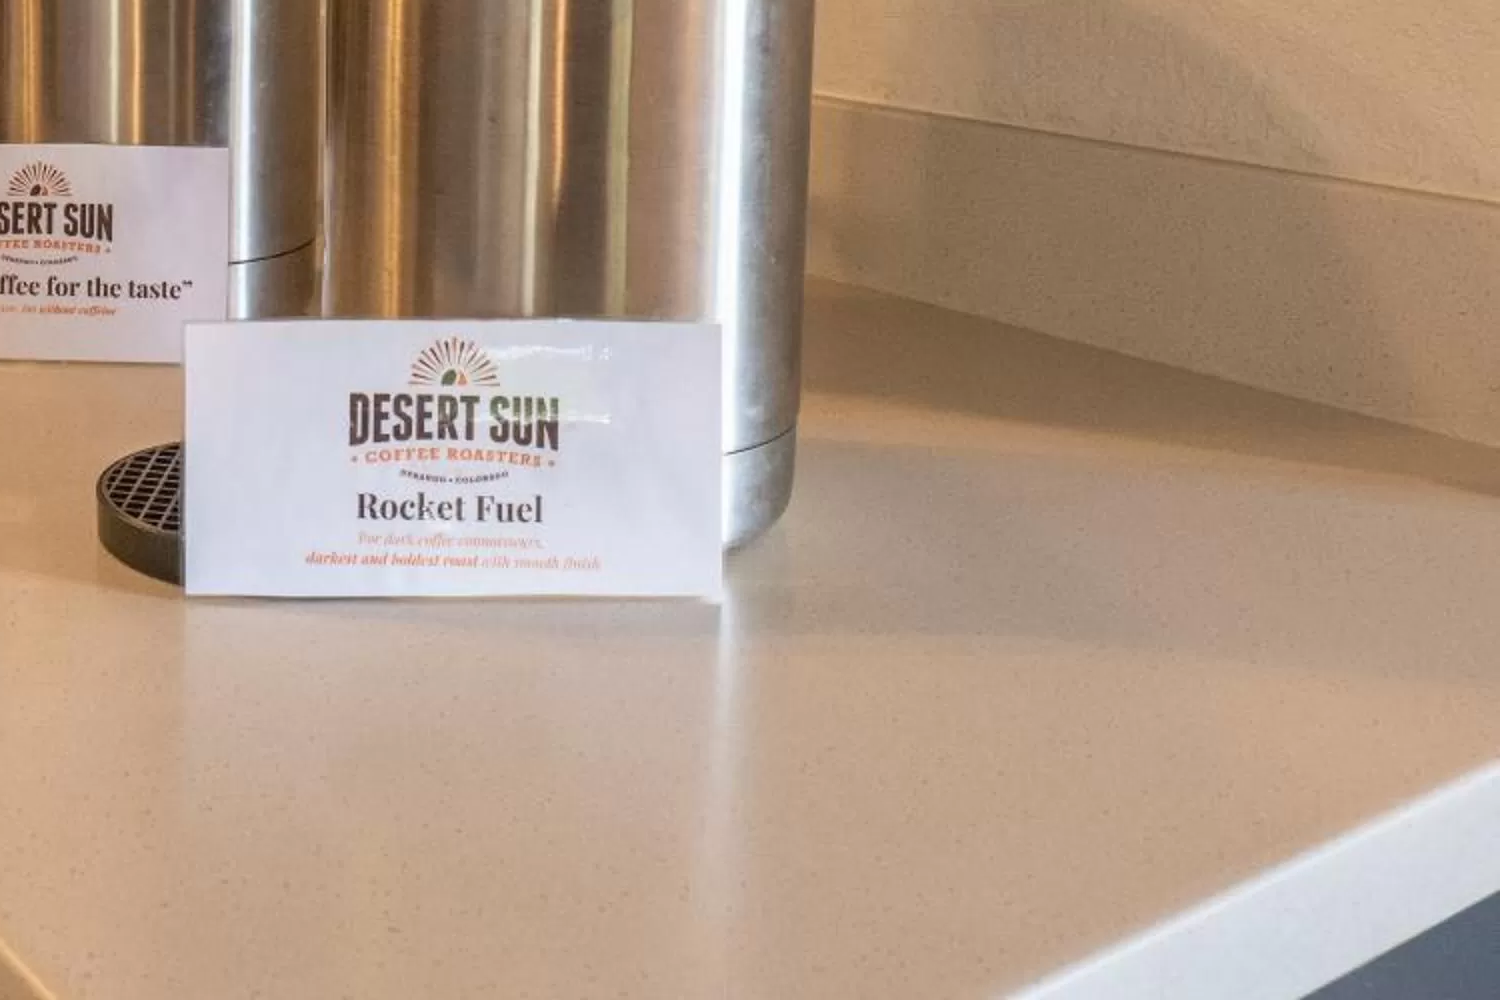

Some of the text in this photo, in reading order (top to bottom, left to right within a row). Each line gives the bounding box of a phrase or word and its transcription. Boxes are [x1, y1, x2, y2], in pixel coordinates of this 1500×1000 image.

[64, 202, 113, 242] SUN
[33, 239, 102, 254] ROASTERS
[47, 275, 81, 297] for
[87, 276, 122, 298] the
[348, 392, 560, 451] DESERT SUN
[365, 447, 542, 467] COFFEE ROASTERS
[357, 491, 544, 523] Rocket Fuel
[305, 551, 357, 566] darkest
[361, 552, 387, 566] and
